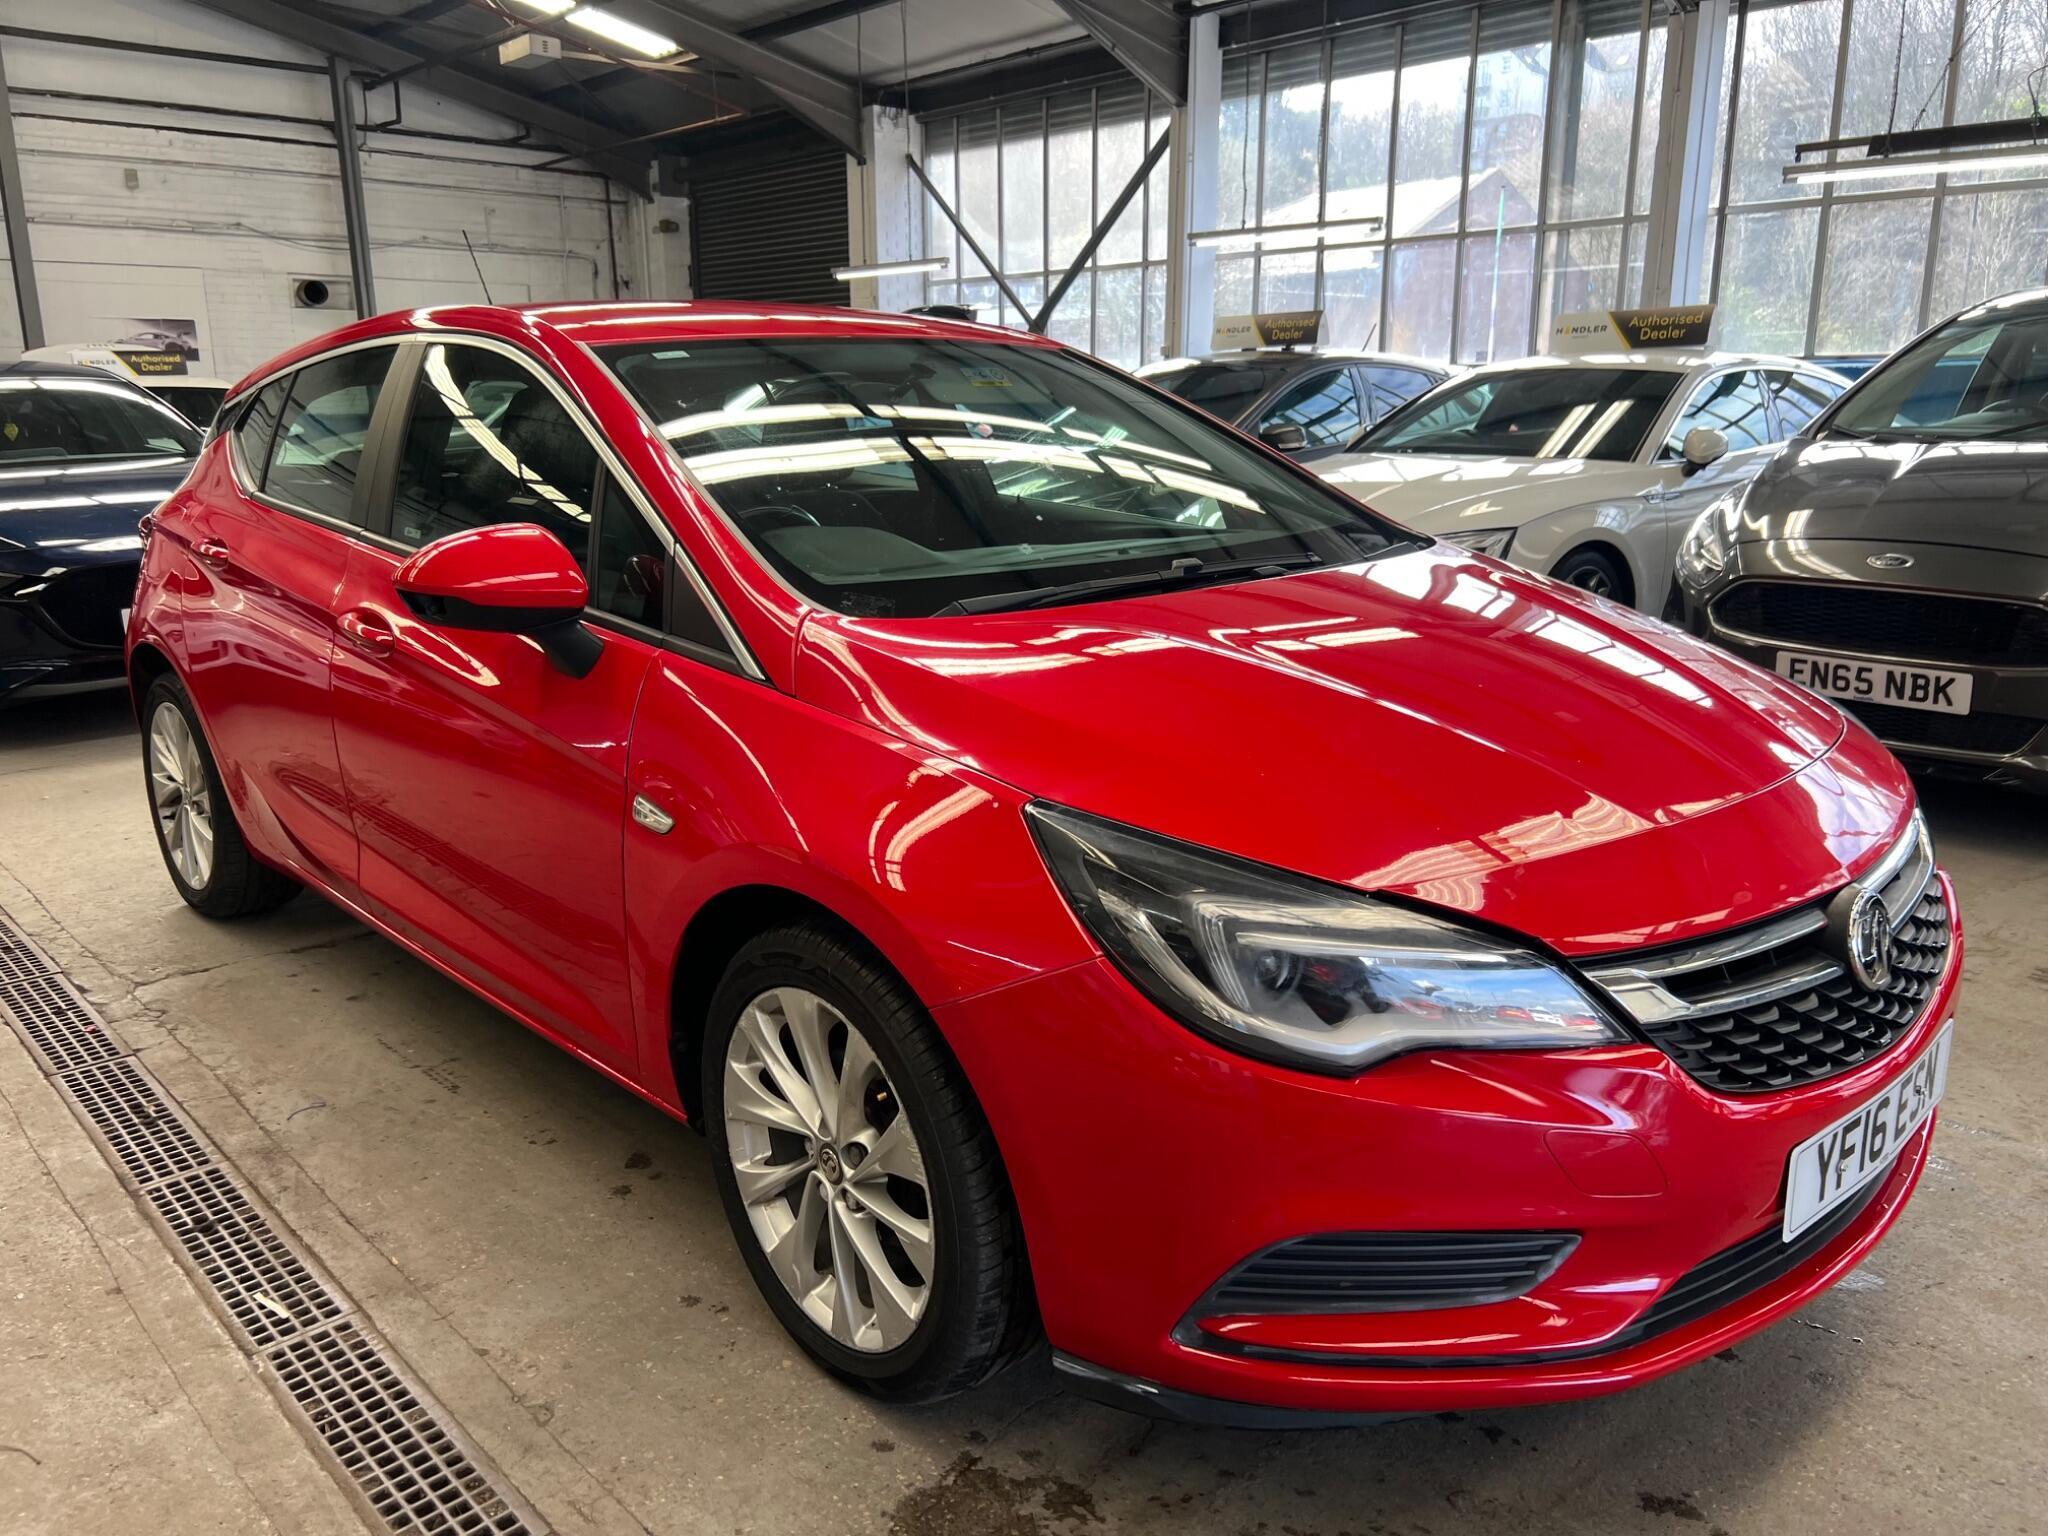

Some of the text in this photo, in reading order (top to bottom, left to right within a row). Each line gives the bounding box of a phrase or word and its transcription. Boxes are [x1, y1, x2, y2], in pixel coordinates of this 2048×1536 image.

[1265, 316, 1317, 328] Authorised
[1629, 311, 1704, 328] Authorised
[1272, 329, 1304, 340] Dealer
[1640, 327, 1685, 341] Dealer
[131, 353, 181, 363] Authorised
[141, 362, 173, 371] Dealer
[1789, 657, 1956, 707] EN65 NBK
[1817, 1041, 1940, 1203] YF16 ESN
